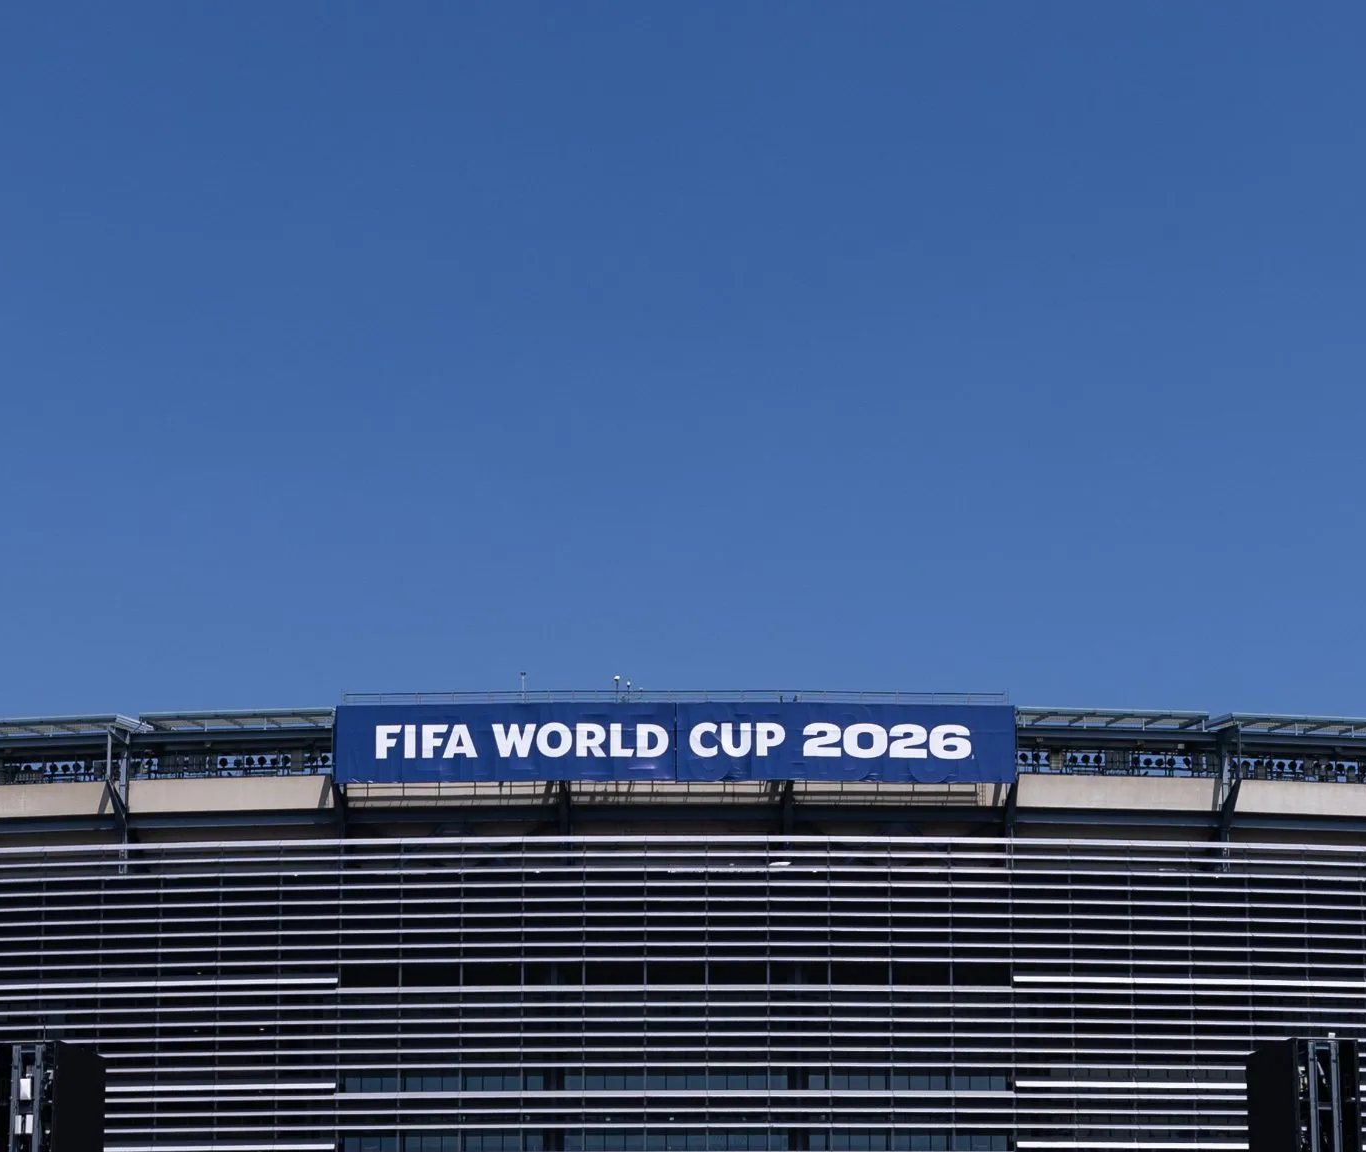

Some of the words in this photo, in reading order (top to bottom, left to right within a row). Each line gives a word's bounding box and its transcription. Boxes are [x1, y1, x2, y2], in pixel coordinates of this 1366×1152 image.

[375, 724, 477, 760] FIFA
[491, 721, 669, 758] WORLD
[689, 721, 786, 758] CUP
[802, 722, 972, 760] 2026
